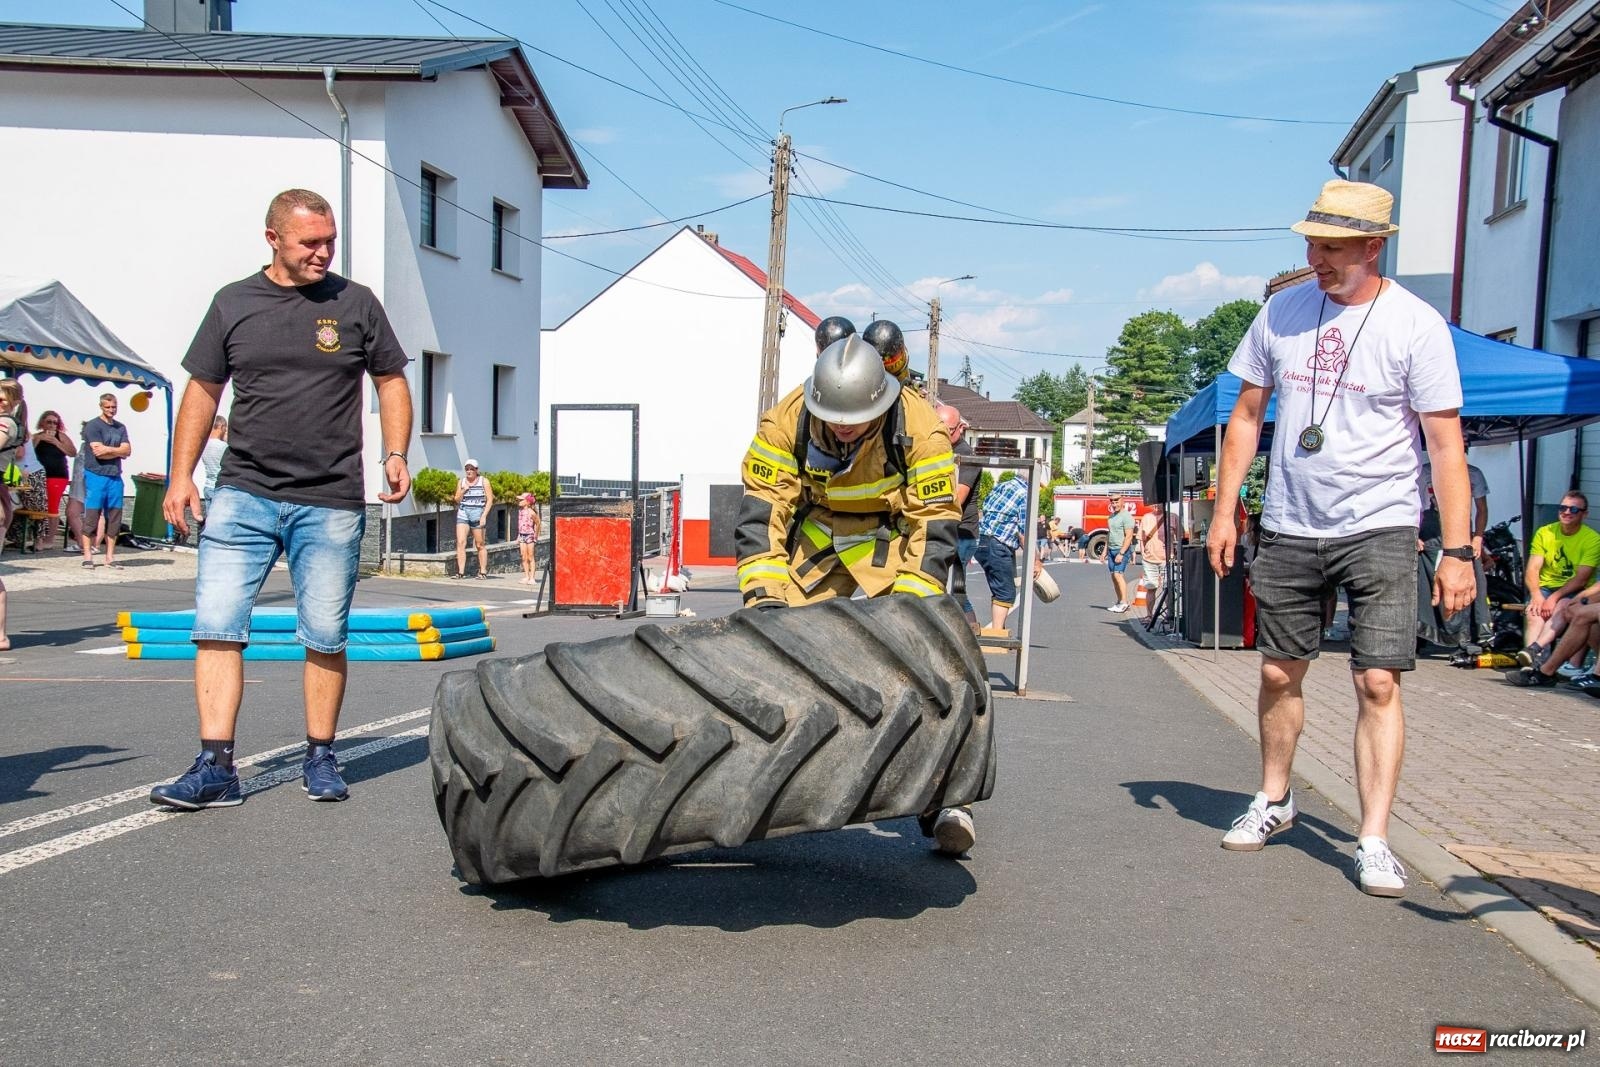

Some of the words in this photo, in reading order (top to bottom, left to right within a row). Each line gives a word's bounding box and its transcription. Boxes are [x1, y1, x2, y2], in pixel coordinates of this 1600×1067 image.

[1296, 385, 1312, 395] OSP
[752, 463, 773, 480] OSP
[922, 480, 947, 496] OSP
